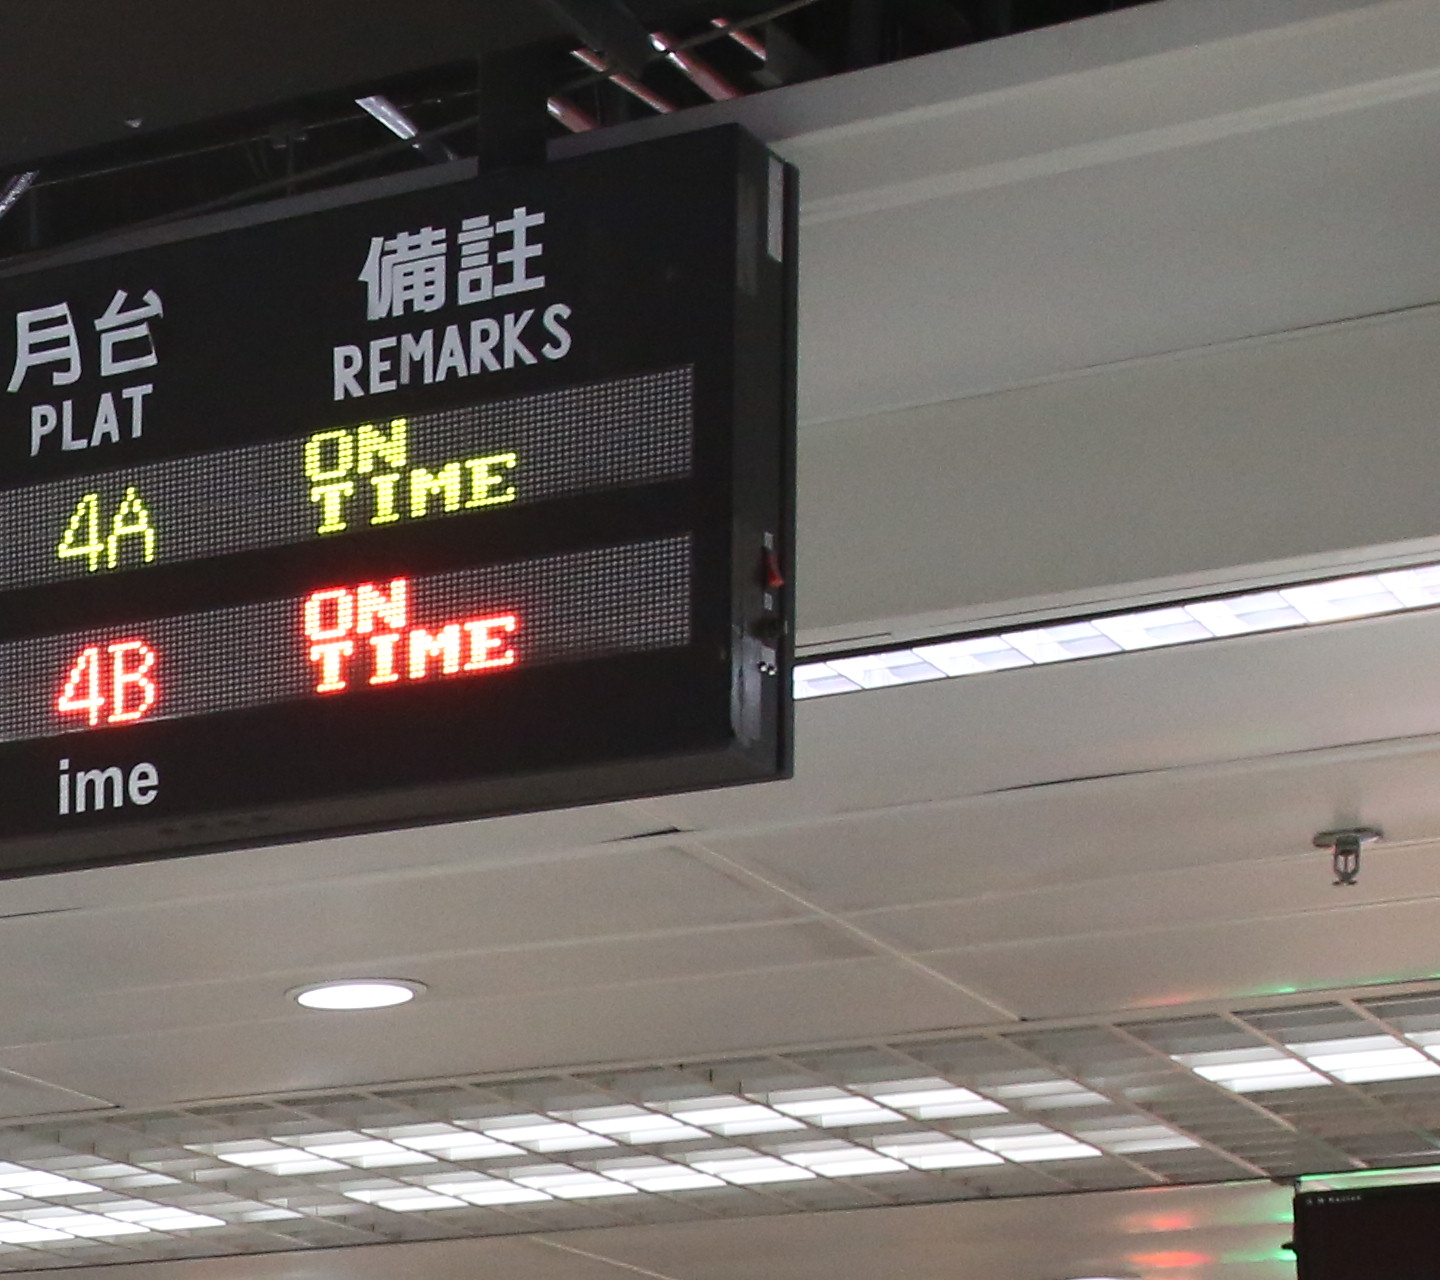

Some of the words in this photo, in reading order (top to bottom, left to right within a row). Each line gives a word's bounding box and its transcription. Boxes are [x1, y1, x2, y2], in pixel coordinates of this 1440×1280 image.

[359, 206, 547, 321] 備註
[7, 288, 163, 393] 月台
[334, 302, 572, 401] REMARKS
[30, 383, 154, 457] PLAT
[304, 417, 408, 485] ON
[58, 485, 156, 573] 4A
[310, 452, 517, 535] TIME
[304, 577, 408, 644] ON
[58, 639, 156, 728] 4B
[310, 615, 517, 694] TIME
